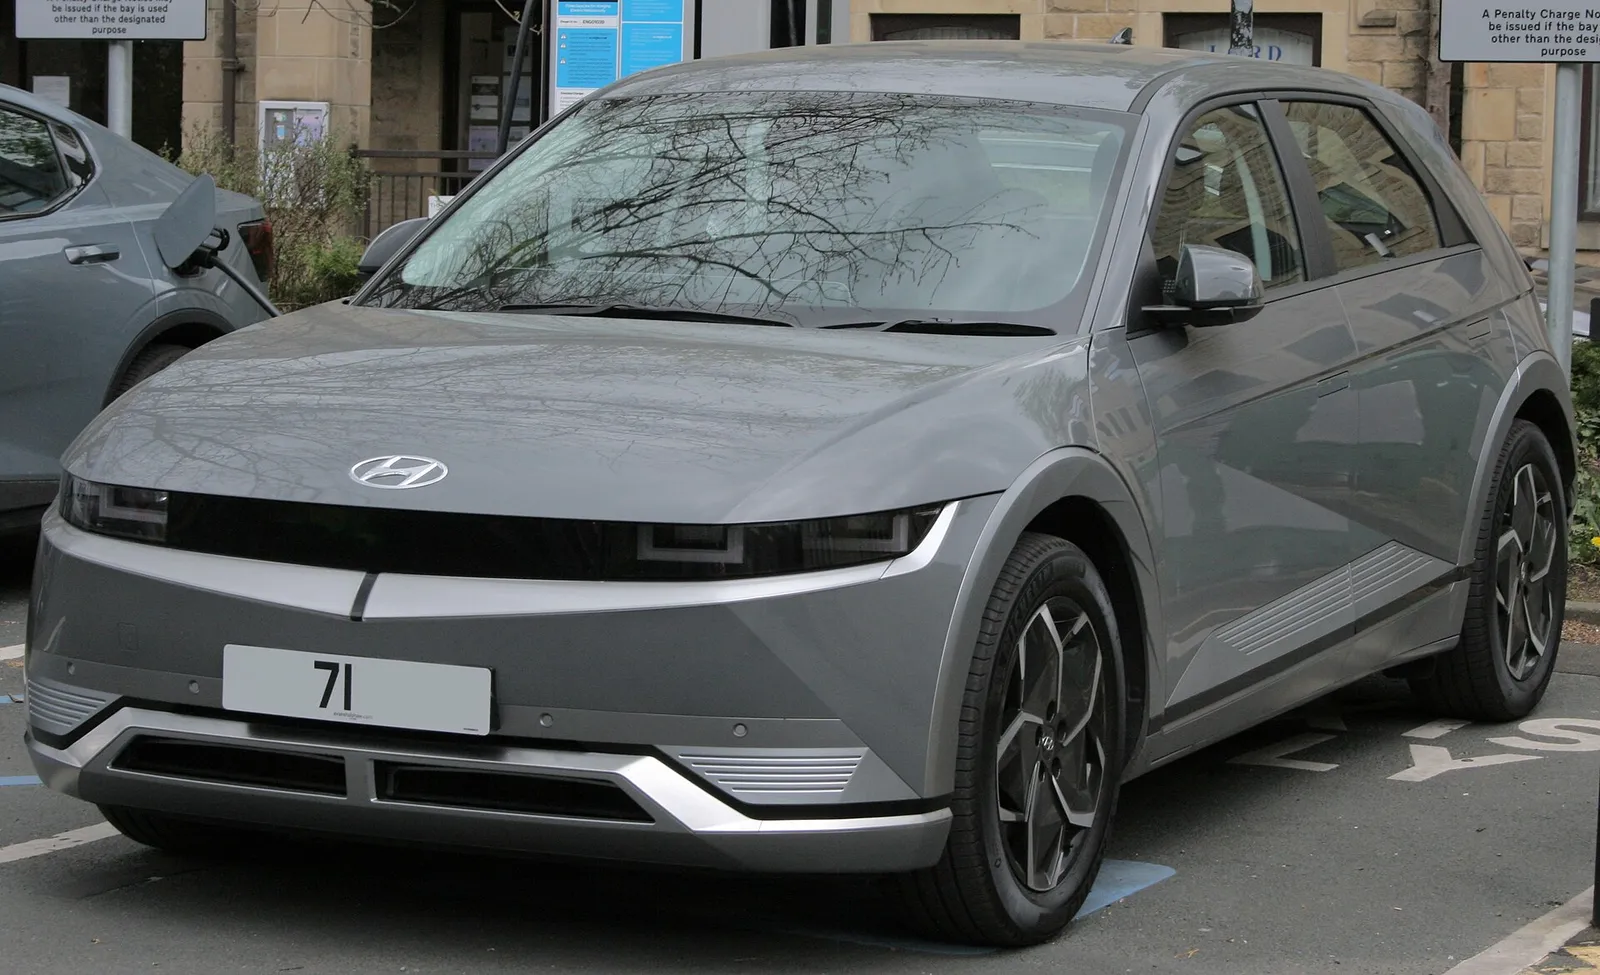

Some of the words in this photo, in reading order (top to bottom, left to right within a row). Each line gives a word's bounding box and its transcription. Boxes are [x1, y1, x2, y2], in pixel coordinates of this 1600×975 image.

[52, 4, 63, 13] be
[65, 4, 92, 13] issued
[94, 4, 101, 13] if
[103, 4, 118, 13] the
[120, 4, 136, 14] bay
[137, 4, 146, 13] is
[148, 4, 168, 13] used
[1482, 9, 1490, 18] A
[1494, 9, 1536, 20] Penalty
[1540, 9, 1580, 20] Charge
[54, 15, 77, 23] other
[80, 15, 99, 23] than
[102, 15, 116, 23] the
[118, 15, 166, 25] designated
[92, 27, 127, 35] purpose
[1488, 22, 1502, 31] be
[1505, 22, 1540, 31] issued
[1544, 22, 1552, 31] if
[1556, 22, 1575, 31] the
[1578, 22, 1598, 33] bay
[1491, 34, 1521, 43] other
[1525, 34, 1550, 43] than
[1554, 34, 1572, 43] the
[1541, 47, 1586, 57] purpose
[314, 660, 352, 711] 71
